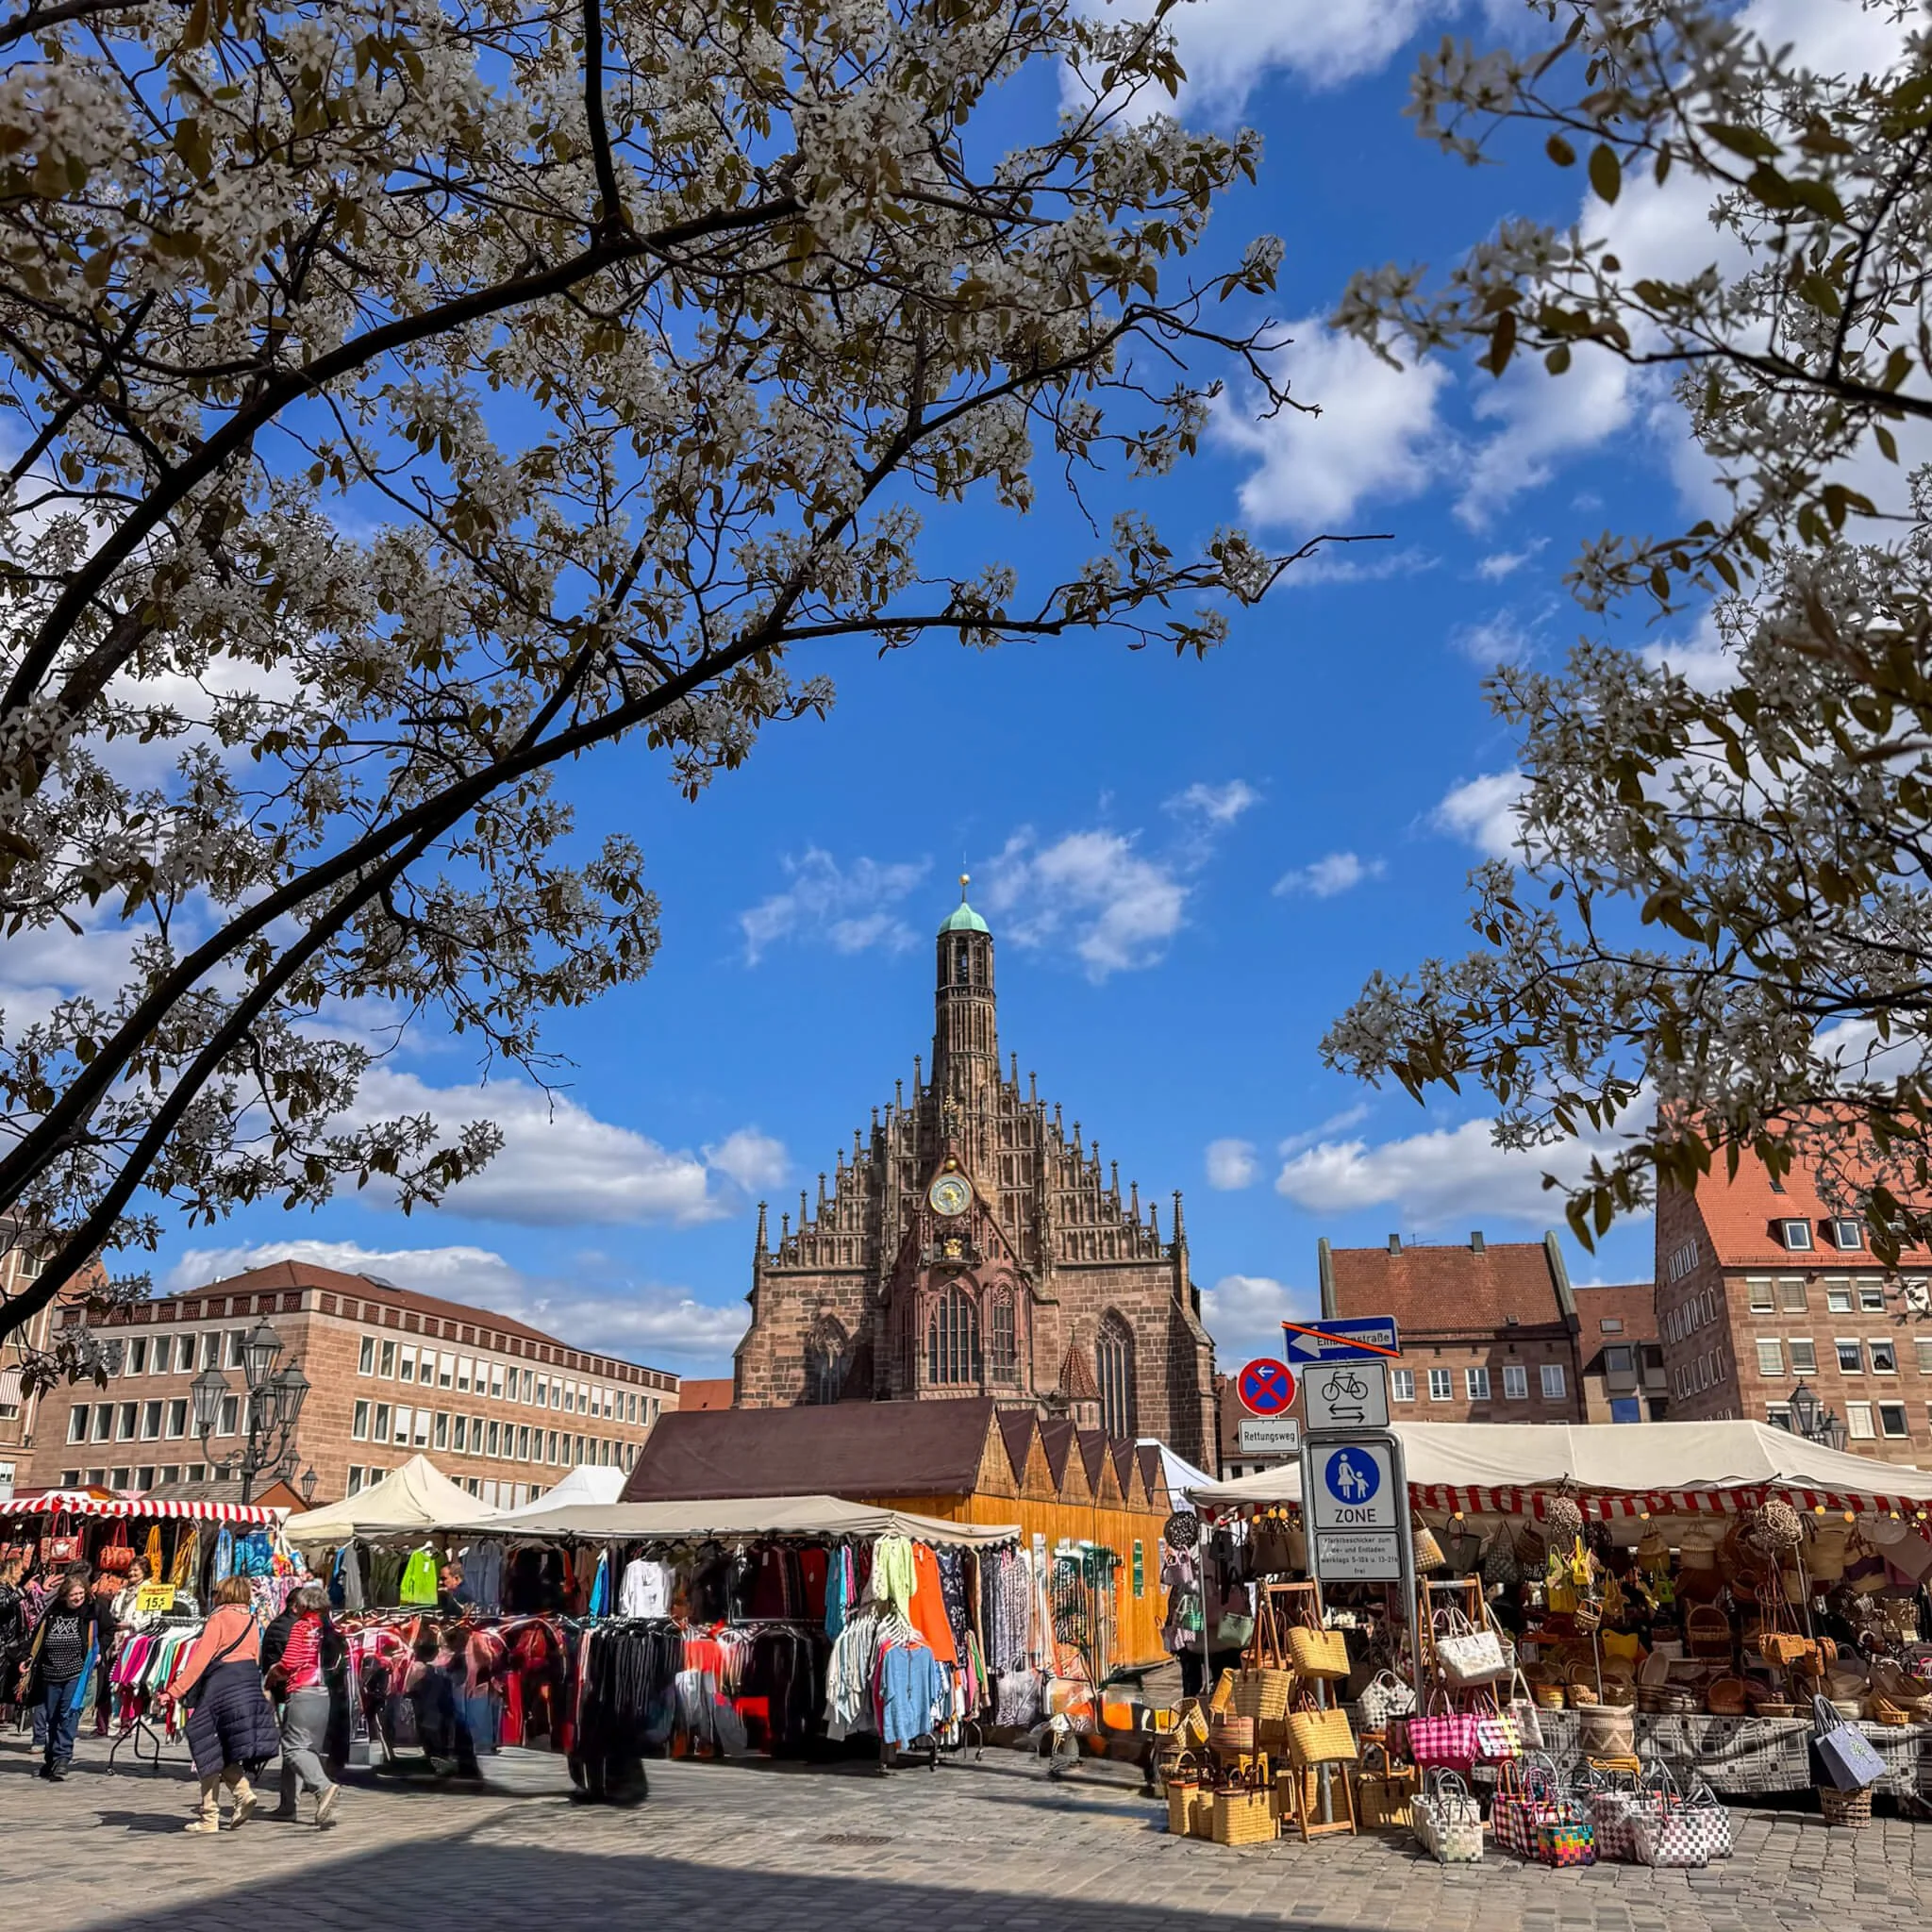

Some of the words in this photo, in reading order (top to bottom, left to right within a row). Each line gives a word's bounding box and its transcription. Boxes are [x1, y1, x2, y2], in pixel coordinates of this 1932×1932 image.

[1317, 1332, 1390, 1346] Einnstraße
[1244, 1431, 1295, 1443] Rettungsweg
[1335, 1508, 1376, 1523] ZONE
